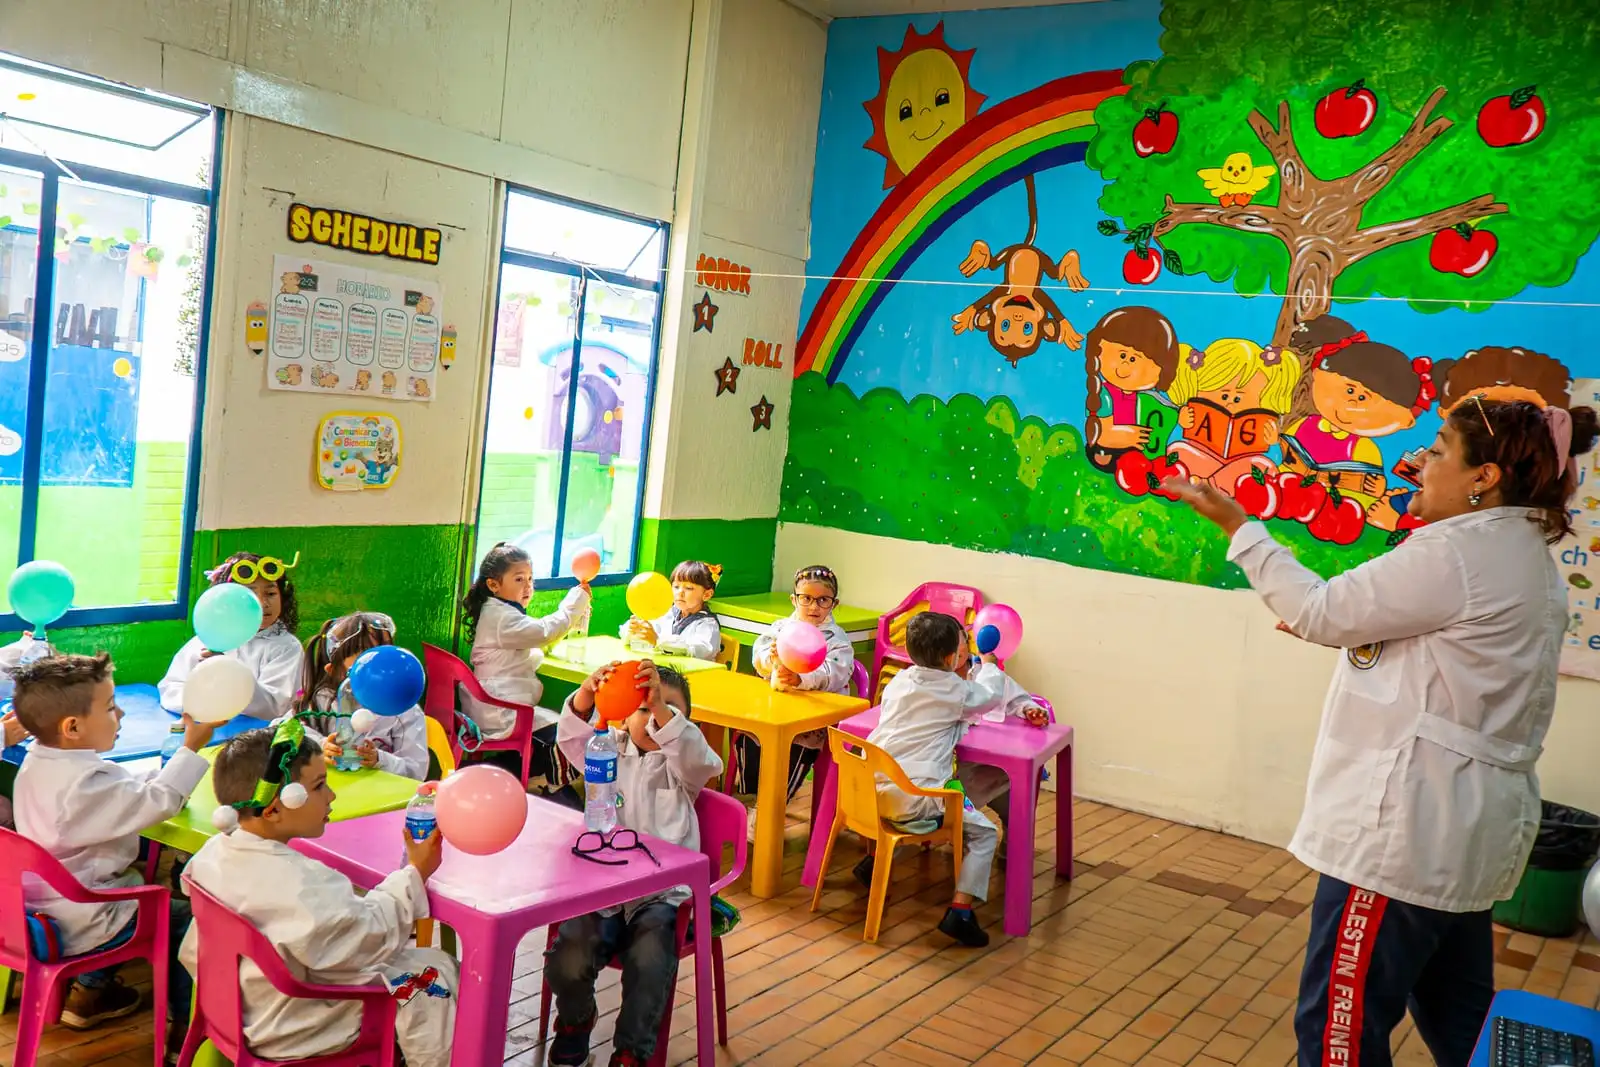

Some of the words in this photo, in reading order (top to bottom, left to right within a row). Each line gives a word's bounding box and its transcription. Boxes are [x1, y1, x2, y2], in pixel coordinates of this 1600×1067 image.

[290, 206, 440, 263] SCHEDULE
[336, 279, 391, 301] HORARIO
[702, 305, 709, 320] 1
[743, 338, 783, 369] ROLL
[725, 369, 732, 382] 2
[759, 405, 766, 420] 3
[1195, 412, 1212, 442] A
[1560, 545, 1588, 566] ch
